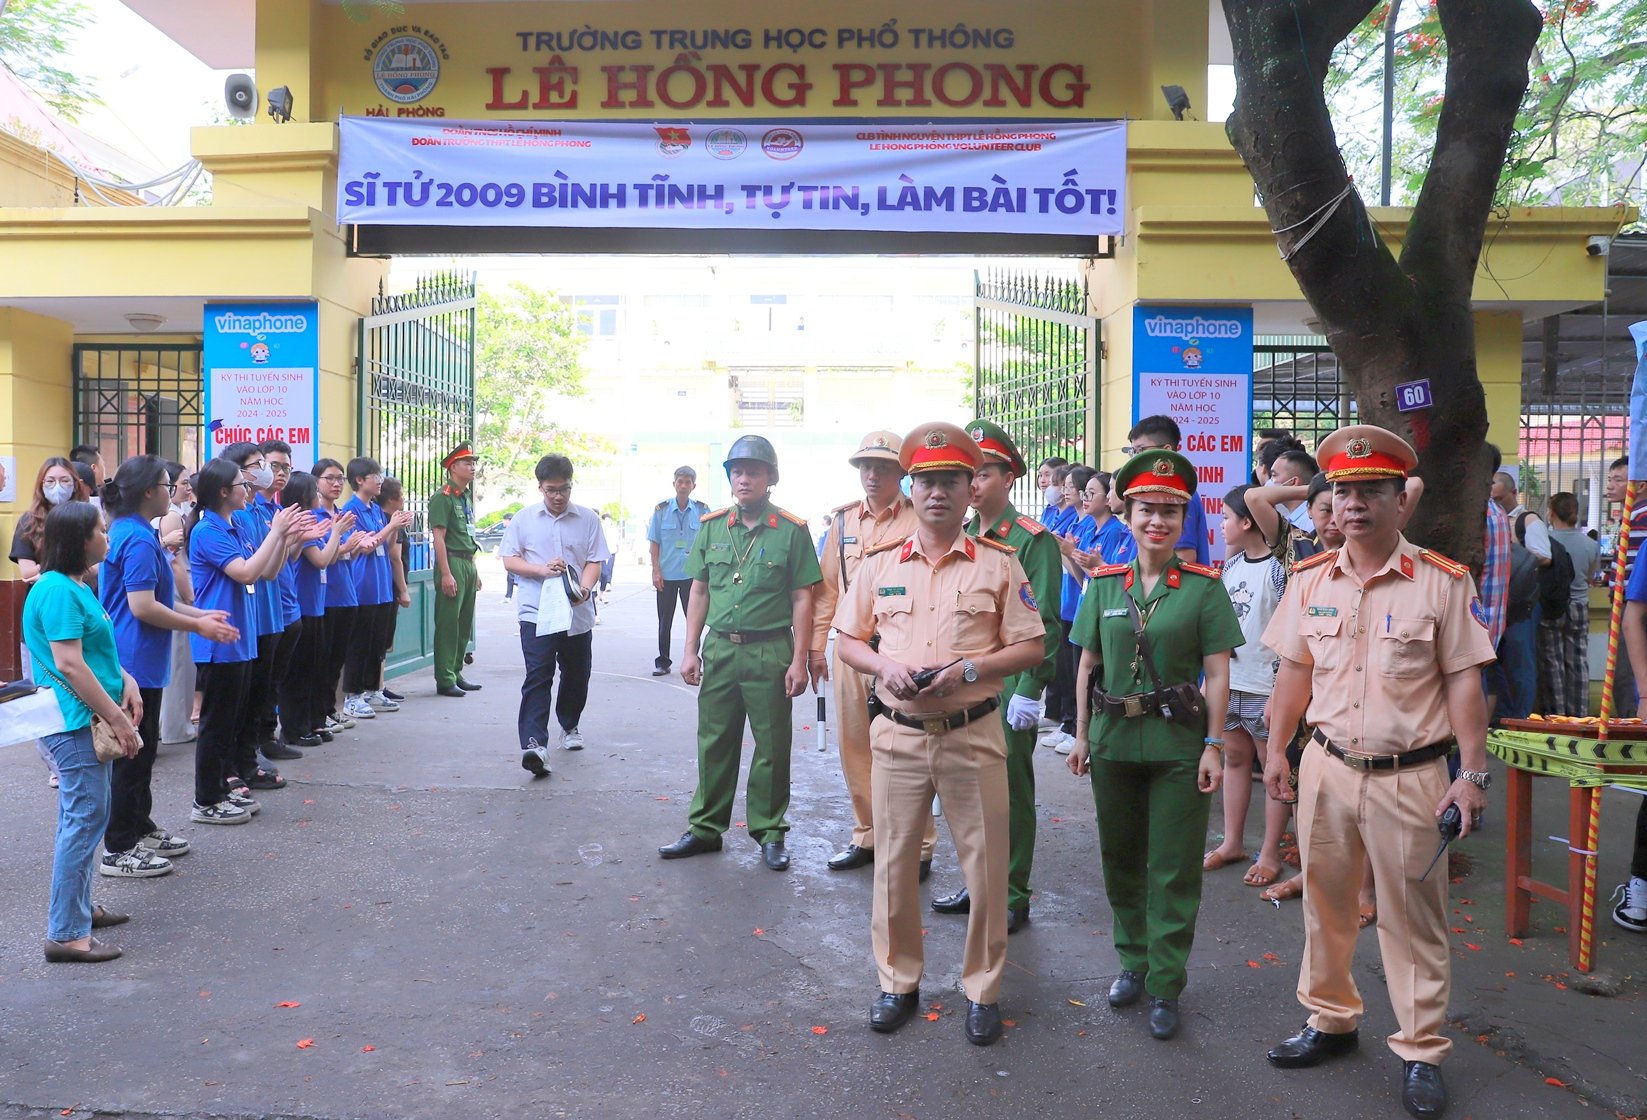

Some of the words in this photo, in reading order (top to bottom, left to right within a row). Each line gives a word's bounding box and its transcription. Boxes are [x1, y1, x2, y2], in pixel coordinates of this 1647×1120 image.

[516, 24, 642, 52] TRƯỜNG
[650, 28, 752, 51] TRUNG
[763, 28, 828, 54] HỌC
[837, 18, 900, 50] PHỔ
[908, 22, 1015, 50] THÔNG
[485, 53, 580, 111] LÊ
[600, 51, 814, 110] HỒNG
[832, 62, 1091, 109] PHONG
[365, 103, 389, 118] HẢI
[397, 104, 446, 118] PHÒNG
[534, 128, 562, 137] MINH
[946, 132, 973, 141] THPT
[1018, 132, 1057, 140] PHONG
[554, 140, 592, 149] PHONG
[869, 143, 882, 151] LE
[882, 143, 914, 151] HONG
[914, 143, 952, 151] PHONG
[952, 142, 1014, 152] VOLUNTEER
[1014, 143, 1042, 152] CLUB
[344, 171, 381, 207] SĨ
[382, 169, 435, 208] TỬ
[435, 182, 526, 208] 2009
[532, 169, 627, 209] BÌNH
[633, 173, 734, 214] TĨNH,
[740, 182, 796, 220] TỰ
[797, 185, 871, 217] TIN,
[877, 173, 957, 212] LÀM
[962, 173, 1027, 214] BÀI
[1034, 168, 1117, 215] TỐT!
[216, 313, 306, 334] vinaphone
[1146, 318, 1240, 339] vinaphone
[234, 373, 249, 381] THI
[282, 373, 304, 381] SINH
[1163, 378, 1180, 387] THI
[1215, 379, 1237, 388] SINH
[1210, 391, 1221, 400] 10
[1403, 385, 1425, 406] 60
[237, 410, 259, 418] 2024
[266, 410, 287, 418] 2025
[1195, 403, 1217, 414] HỌC
[1172, 416, 1189, 424] 024
[1197, 416, 1220, 425] 2025
[215, 424, 252, 444] CHÚC
[256, 424, 284, 444] CÁC
[289, 427, 310, 444] EM
[1187, 432, 1216, 452] CÁC
[1220, 435, 1243, 452] EM
[1200, 494, 1225, 515] ĨNH
